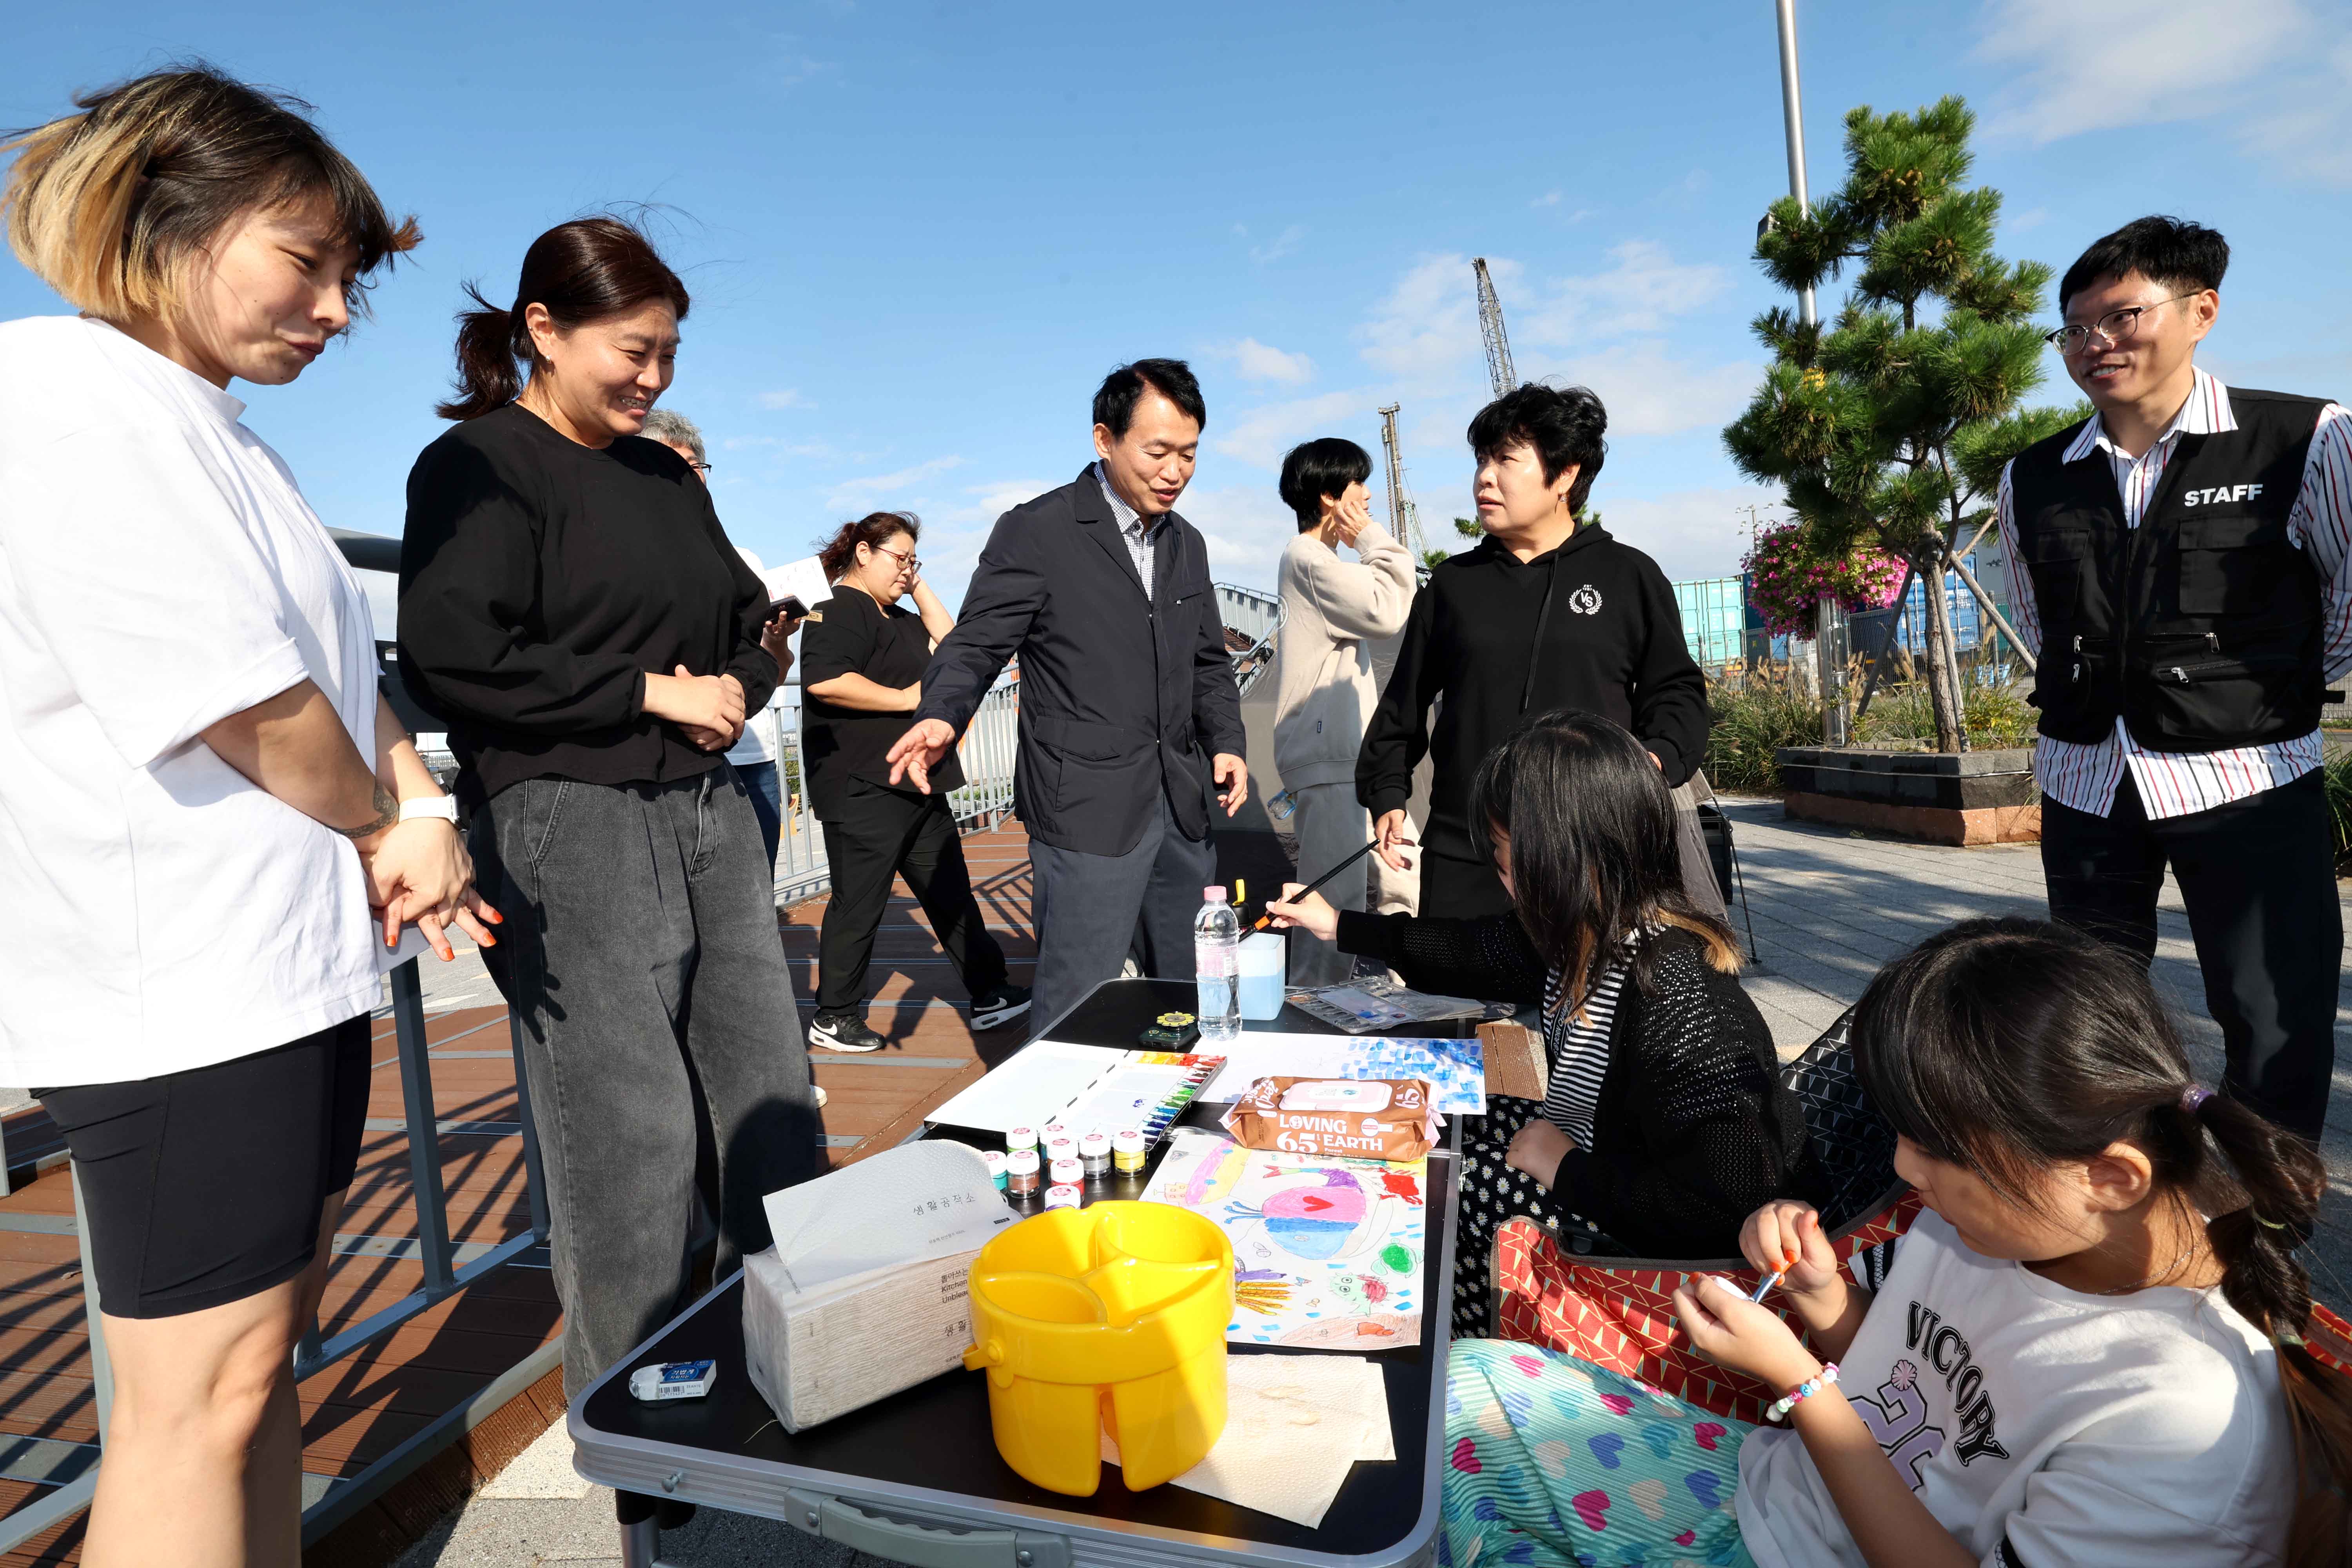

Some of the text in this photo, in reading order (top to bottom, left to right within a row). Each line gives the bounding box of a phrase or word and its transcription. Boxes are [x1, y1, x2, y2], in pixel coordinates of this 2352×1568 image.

[2184, 484, 2263, 507] STAFF
[1581, 592, 1593, 607] VS
[1279, 1114, 1347, 1135] LOVING
[1276, 1131, 1318, 1153] 65
[1323, 1134, 1383, 1152] EARTH
[913, 1192, 976, 1216] 생활공작소
[941, 1279, 968, 1293] Kitchen
[1906, 1301, 2009, 1467] VICTORY
